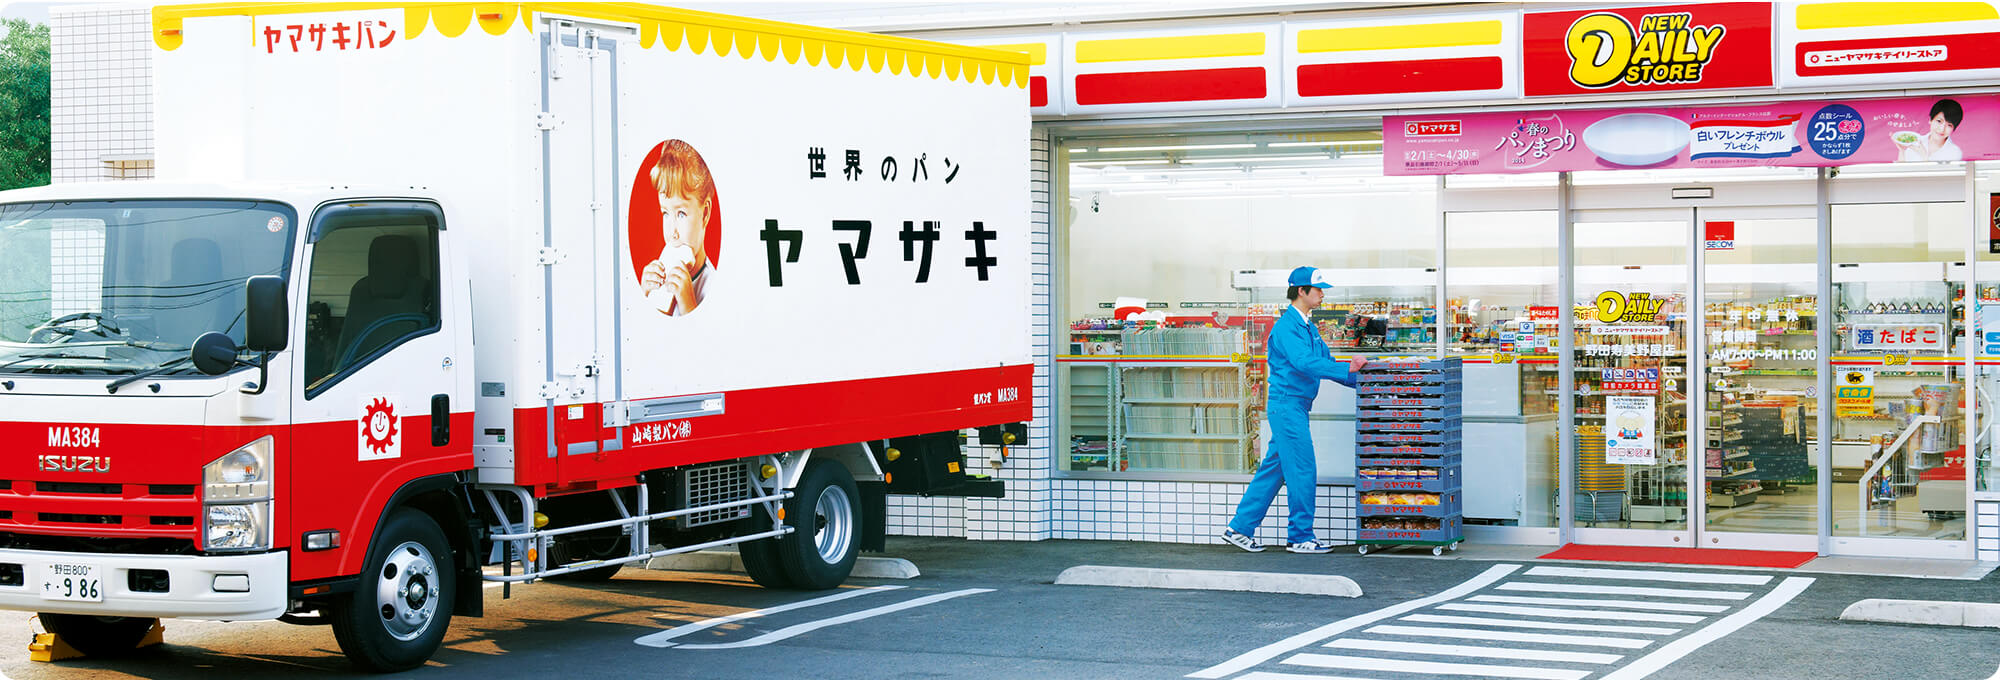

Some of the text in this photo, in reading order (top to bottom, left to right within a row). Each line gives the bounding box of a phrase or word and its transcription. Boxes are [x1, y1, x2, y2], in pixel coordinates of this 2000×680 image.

[1641, 14, 1690, 33] NEW
[264, 20, 396, 54] ヤマザキパン
[1566, 13, 1724, 88] DAILY
[1825, 49, 1942, 63] ニューヤマザキデイリーストア
[1625, 62, 1702, 83] STORE
[1420, 123, 1459, 133] ヤマザキ
[1527, 122, 1549, 136] 春の
[1697, 130, 1785, 142] 白いフレンチボウル
[1813, 121, 1837, 142] 25
[1495, 128, 1577, 158] パンまつり
[1723, 142, 1760, 151] プレゼント
[807, 146, 960, 184] 世界のパン
[1706, 240, 1734, 248] SECOM
[760, 219, 998, 287] ヤマザキ
[1629, 292, 1651, 300] NEW
[1596, 290, 1664, 323] DAILY
[1621, 313, 1657, 322] STORE
[1857, 328, 1937, 344] 酒 たばこ
[997, 386, 1018, 402] MA384
[48, 427, 100, 448] MA384
[38, 455, 111, 472] ISUZU
